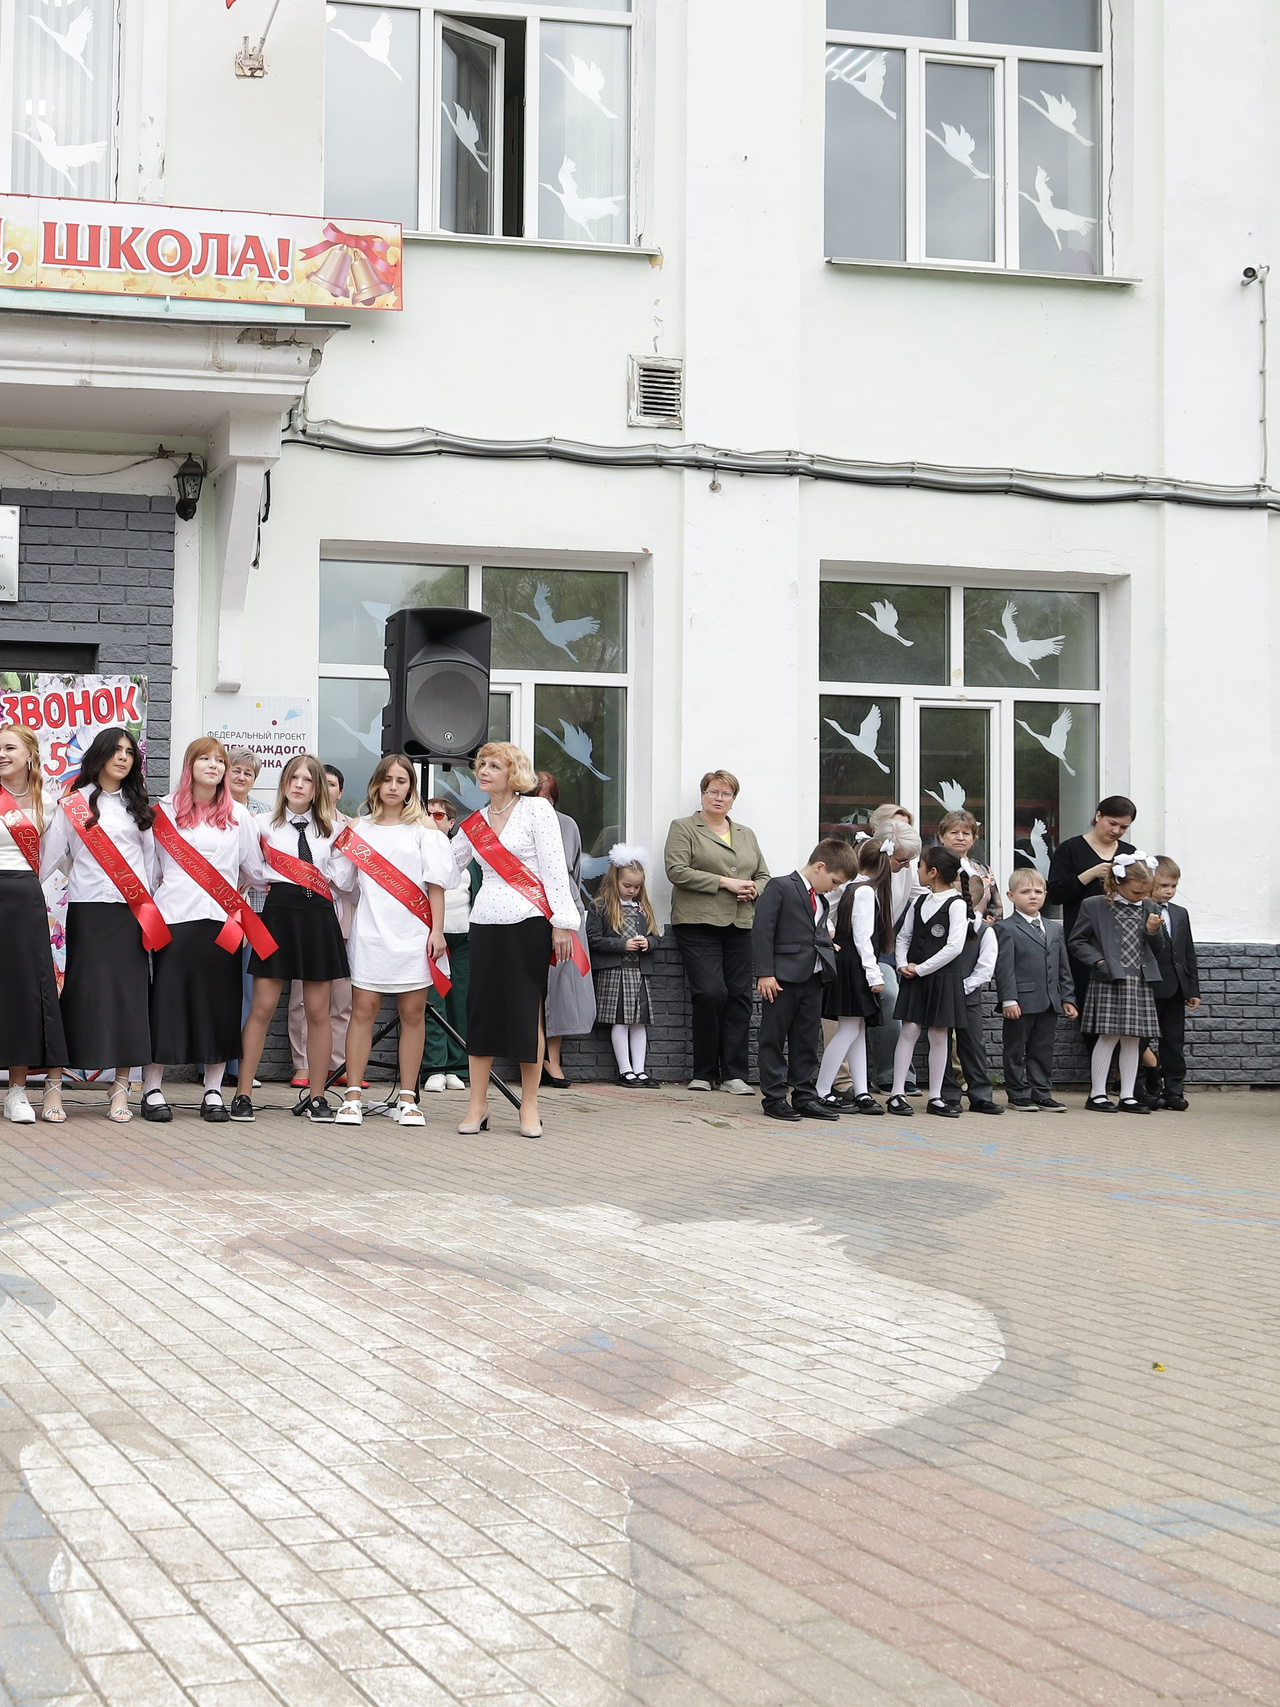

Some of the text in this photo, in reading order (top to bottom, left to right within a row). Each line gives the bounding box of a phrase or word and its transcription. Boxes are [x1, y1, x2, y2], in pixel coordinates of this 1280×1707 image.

[41, 222, 293, 282] ШКОЛА!
[2, 684, 140, 731] ЗВОНОК
[207, 731, 307, 741] ФЕДЕРАЛЬНЫЙ ПРОЕКТ
[113, 866, 145, 901] 2025
[161, 828, 213, 885] Выпускница
[211, 880, 243, 913] 2025
[351, 843, 411, 898] Выпускница
